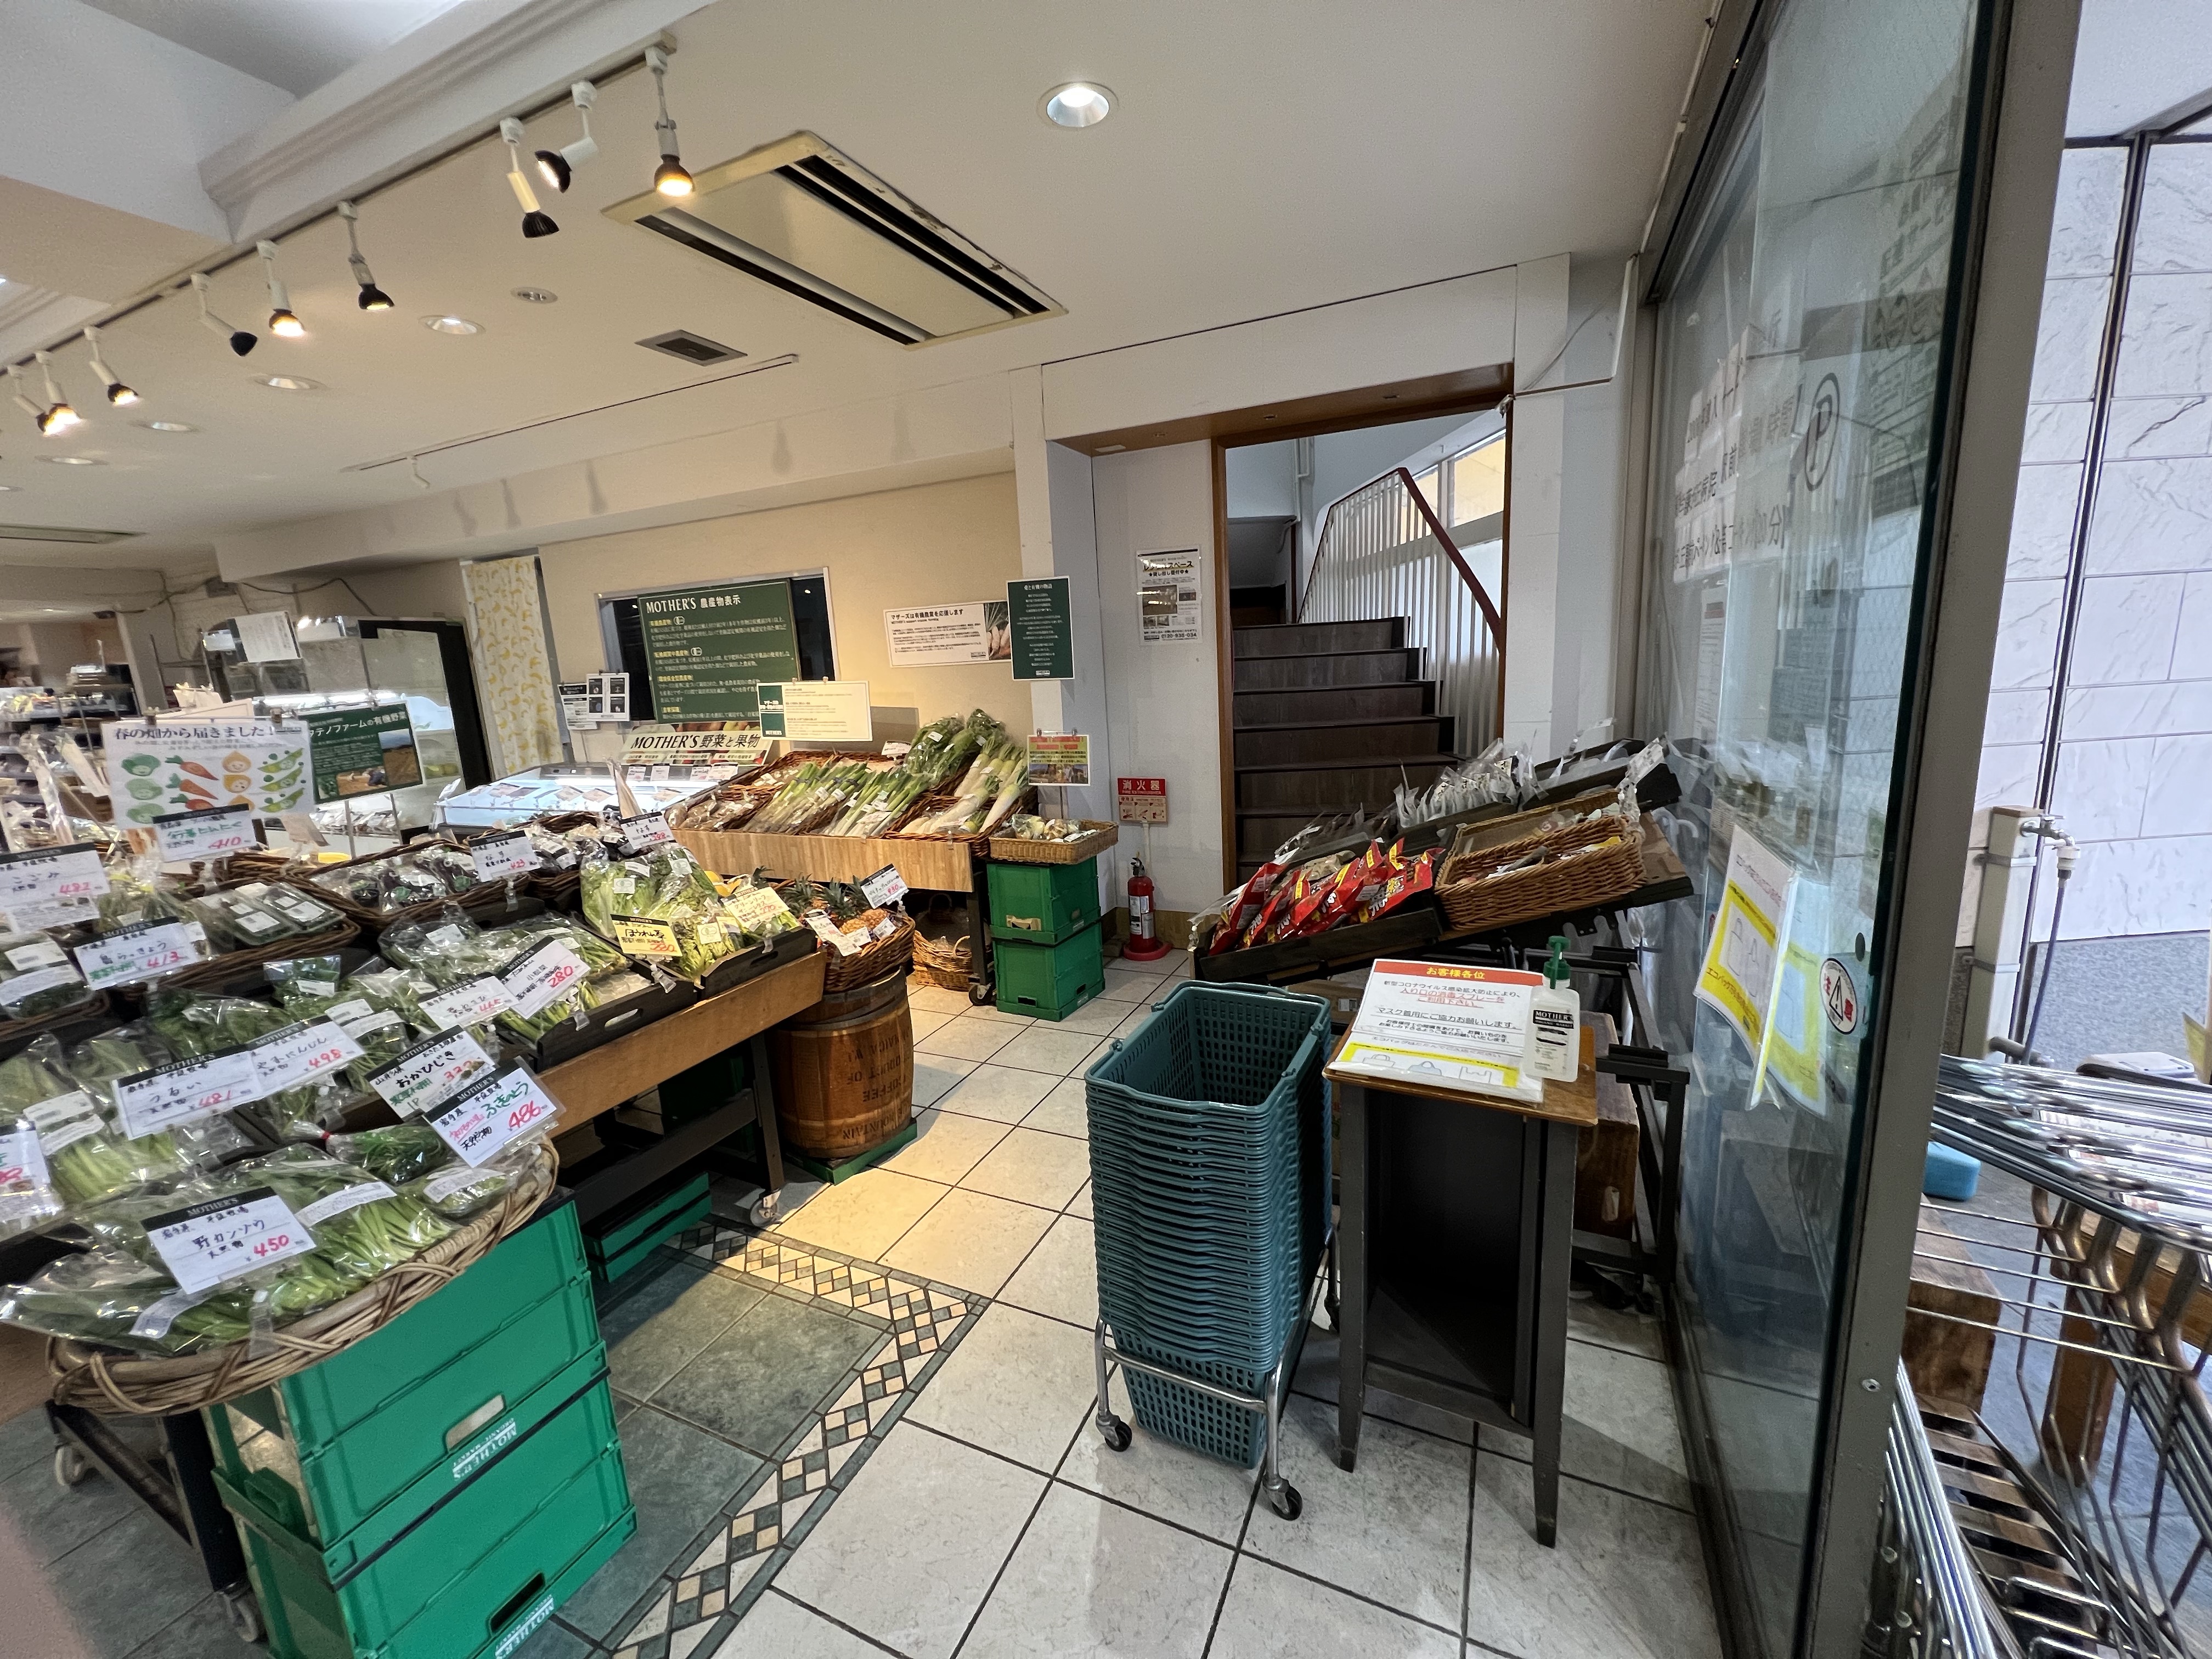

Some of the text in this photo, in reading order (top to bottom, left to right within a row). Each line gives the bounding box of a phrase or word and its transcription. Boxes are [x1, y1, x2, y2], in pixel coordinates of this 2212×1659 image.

[1143, 560, 1195, 572] レスペース
[646, 594, 741, 614] MOTHER'S 農産物表示
[630, 733, 761, 750] MOTHER'S 野菜と果物
[1122, 780, 1160, 791] 消火器
[546, 965, 574, 989] 280
[1426, 967, 1486, 980] お客様各位
[1378, 1006, 1517, 1030] マスク着用にご協力お願いします。
[396, 1050, 456, 1089] おかひじき
[456, 1075, 495, 1102] MOTHER'S
[507, 1100, 543, 1130] 486
[253, 1234, 290, 1257] 450
[453, 1427, 517, 1481] MOTHER'S
